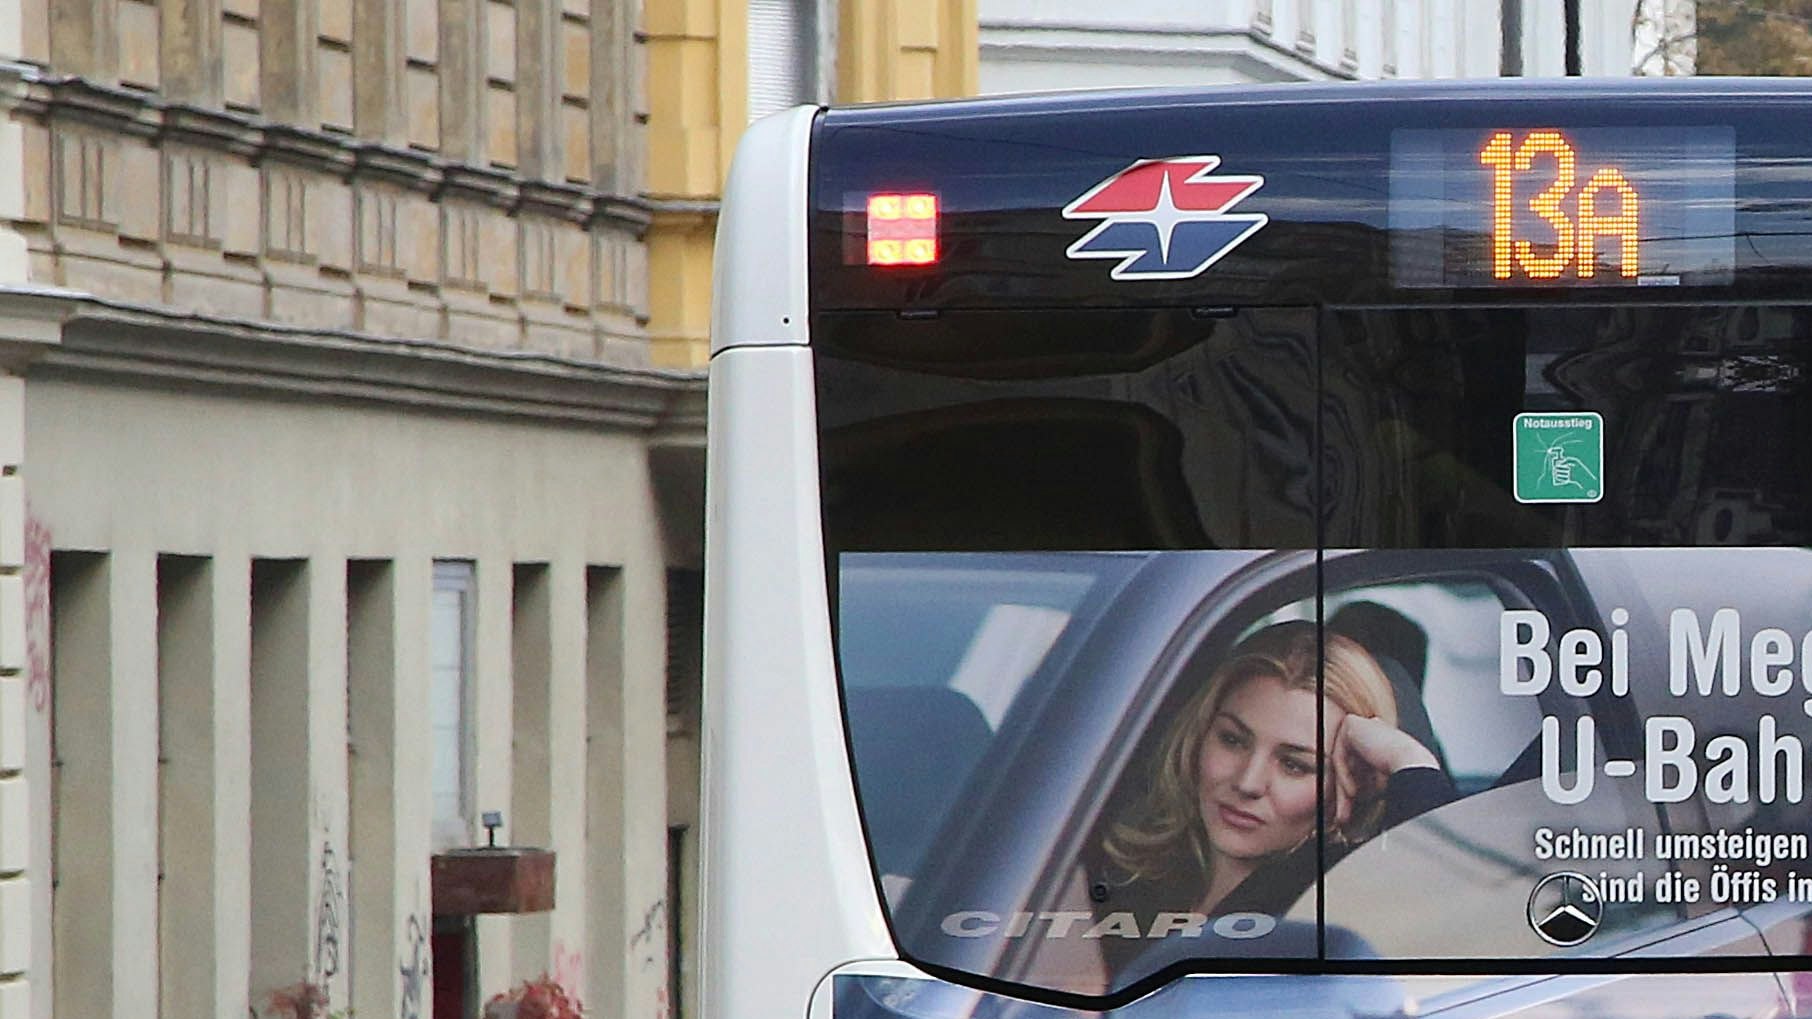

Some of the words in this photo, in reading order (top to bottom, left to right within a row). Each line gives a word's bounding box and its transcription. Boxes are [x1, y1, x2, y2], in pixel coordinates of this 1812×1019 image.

[1480, 131, 1639, 279] 13A
[1523, 418, 1593, 430] Notausstieg
[1500, 608, 1629, 697] Bei
[1534, 828, 1644, 860] Schnell
[1655, 828, 1808, 866] umsteigen
[1581, 872, 1644, 904] sind
[1655, 872, 1700, 904] die
[1710, 865, 1777, 904] Öffis
[940, 911, 1277, 939] CITARO
